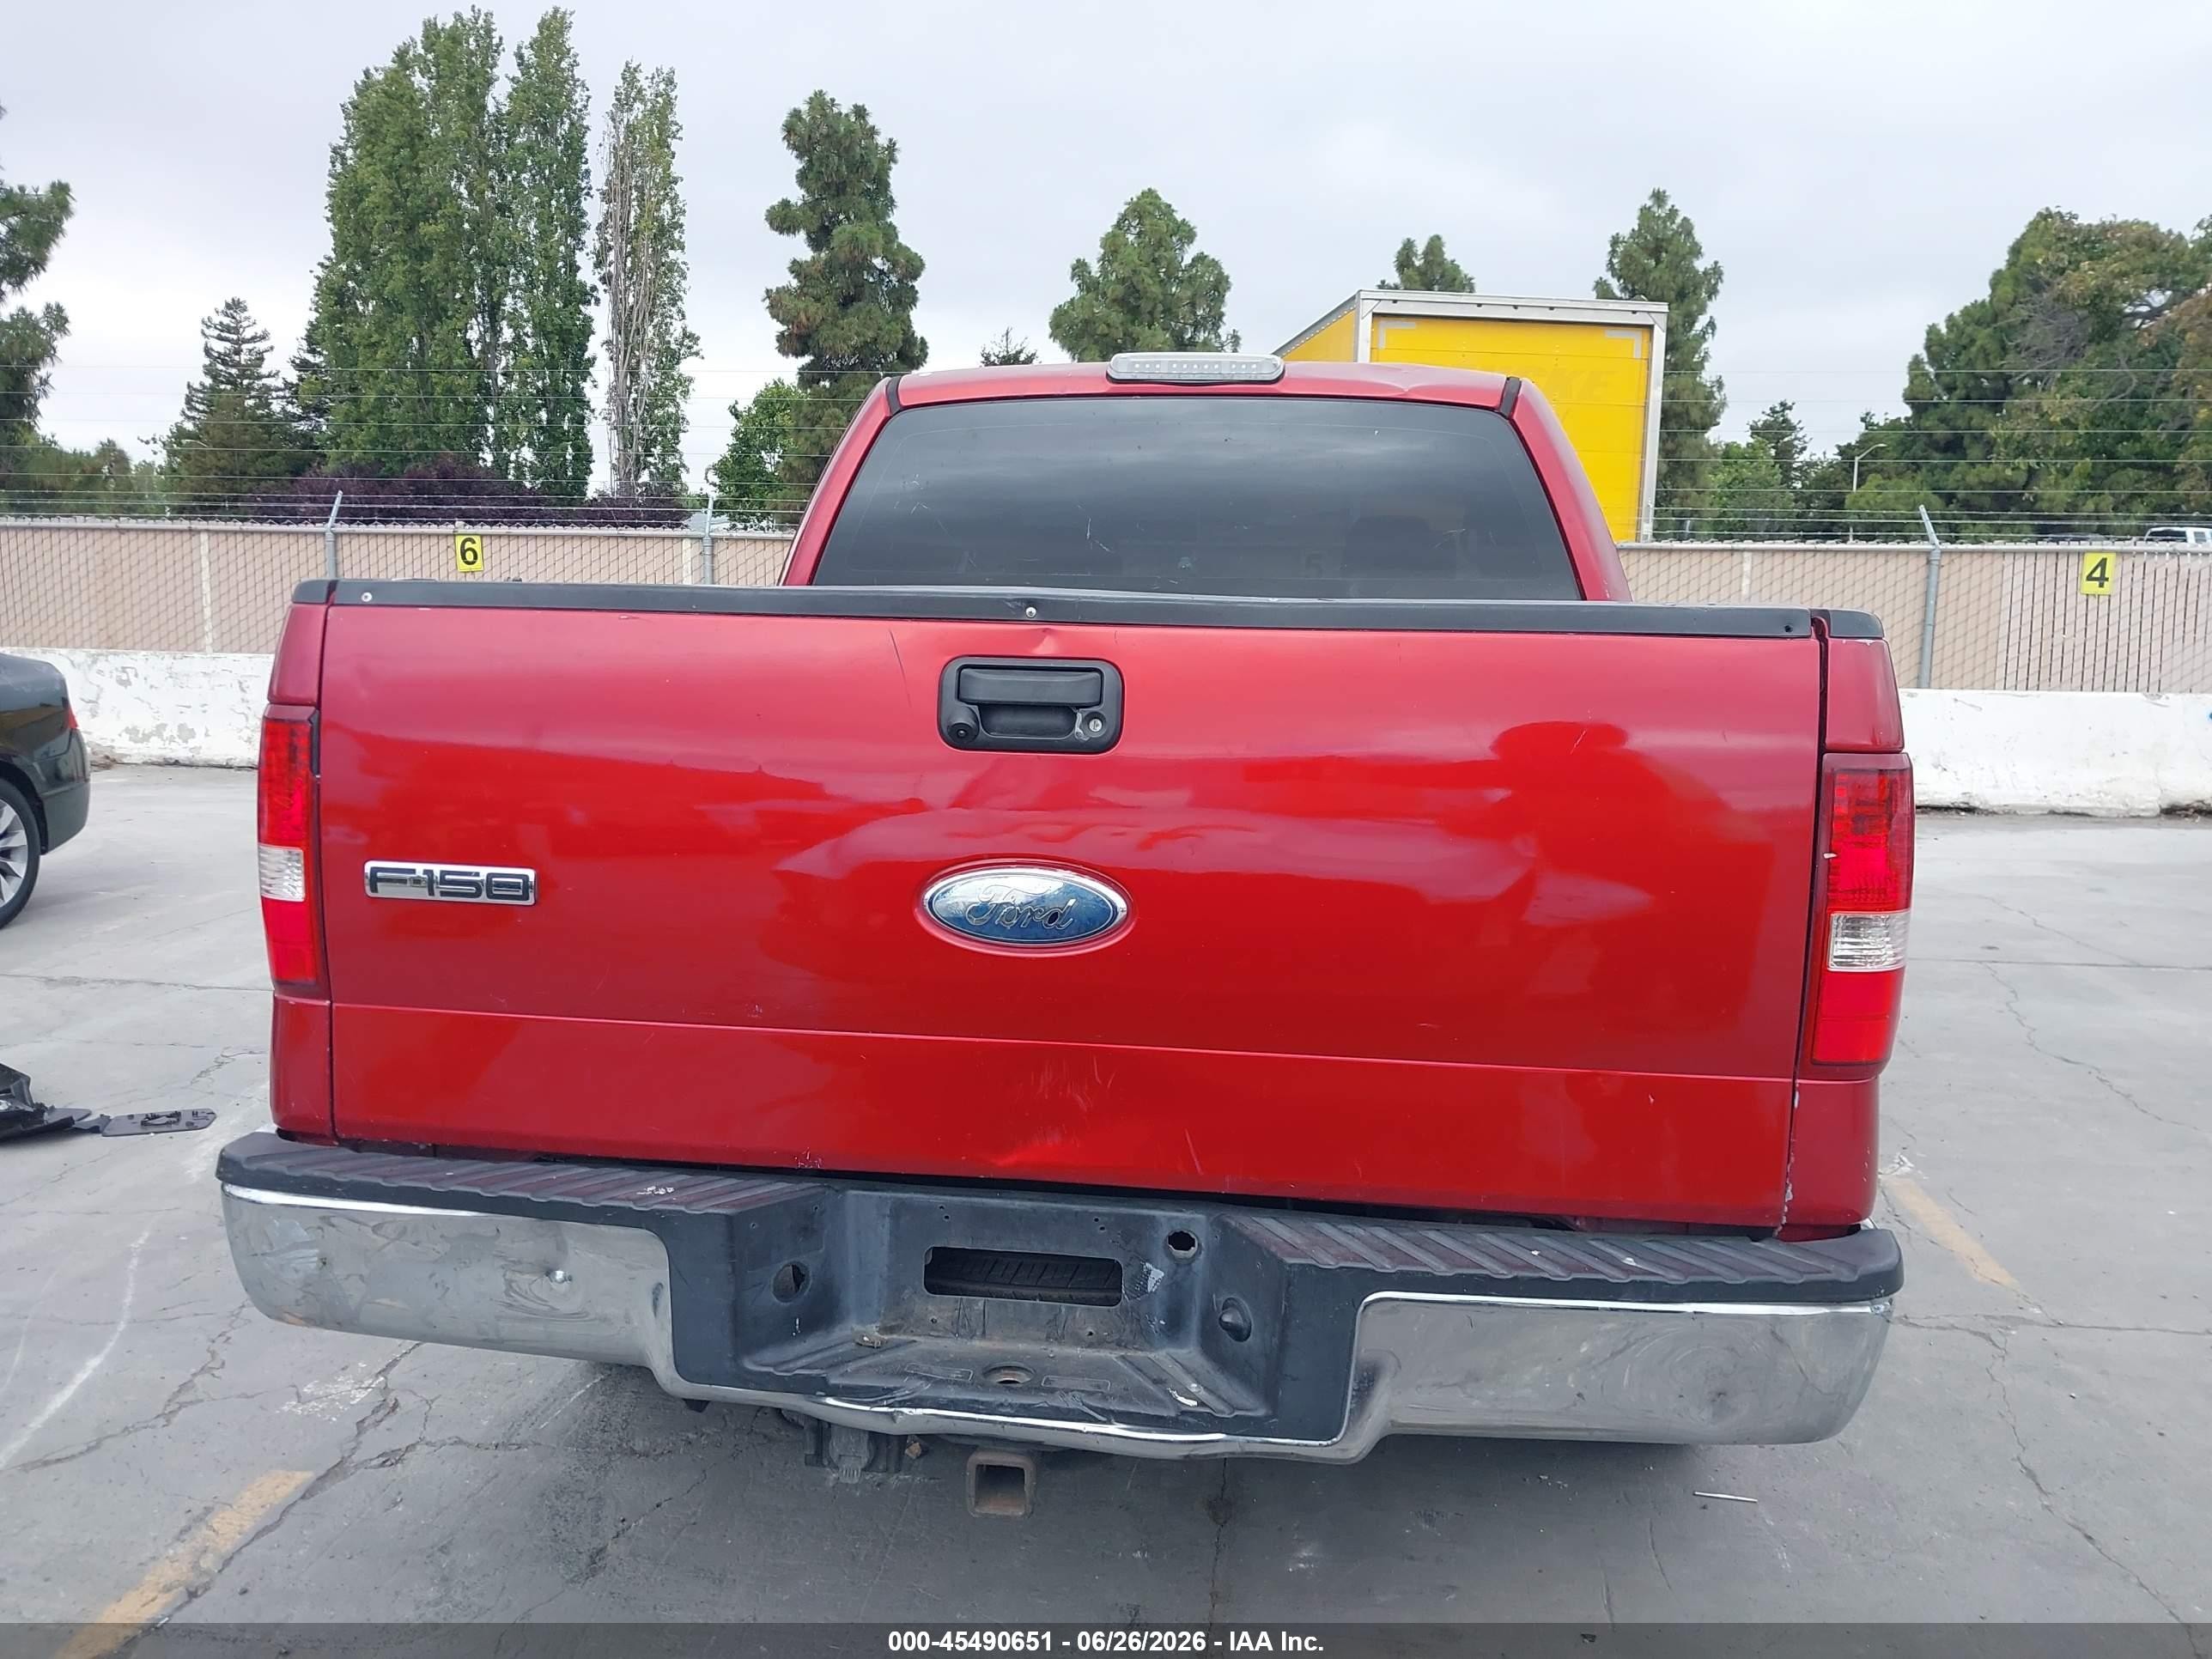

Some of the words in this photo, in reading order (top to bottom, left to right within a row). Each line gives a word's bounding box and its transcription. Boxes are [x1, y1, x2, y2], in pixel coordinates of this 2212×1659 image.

[459, 537, 478, 566] 6
[2086, 557, 2110, 588] 4
[369, 866, 530, 902] F-150
[965, 884, 1078, 931] Ford
